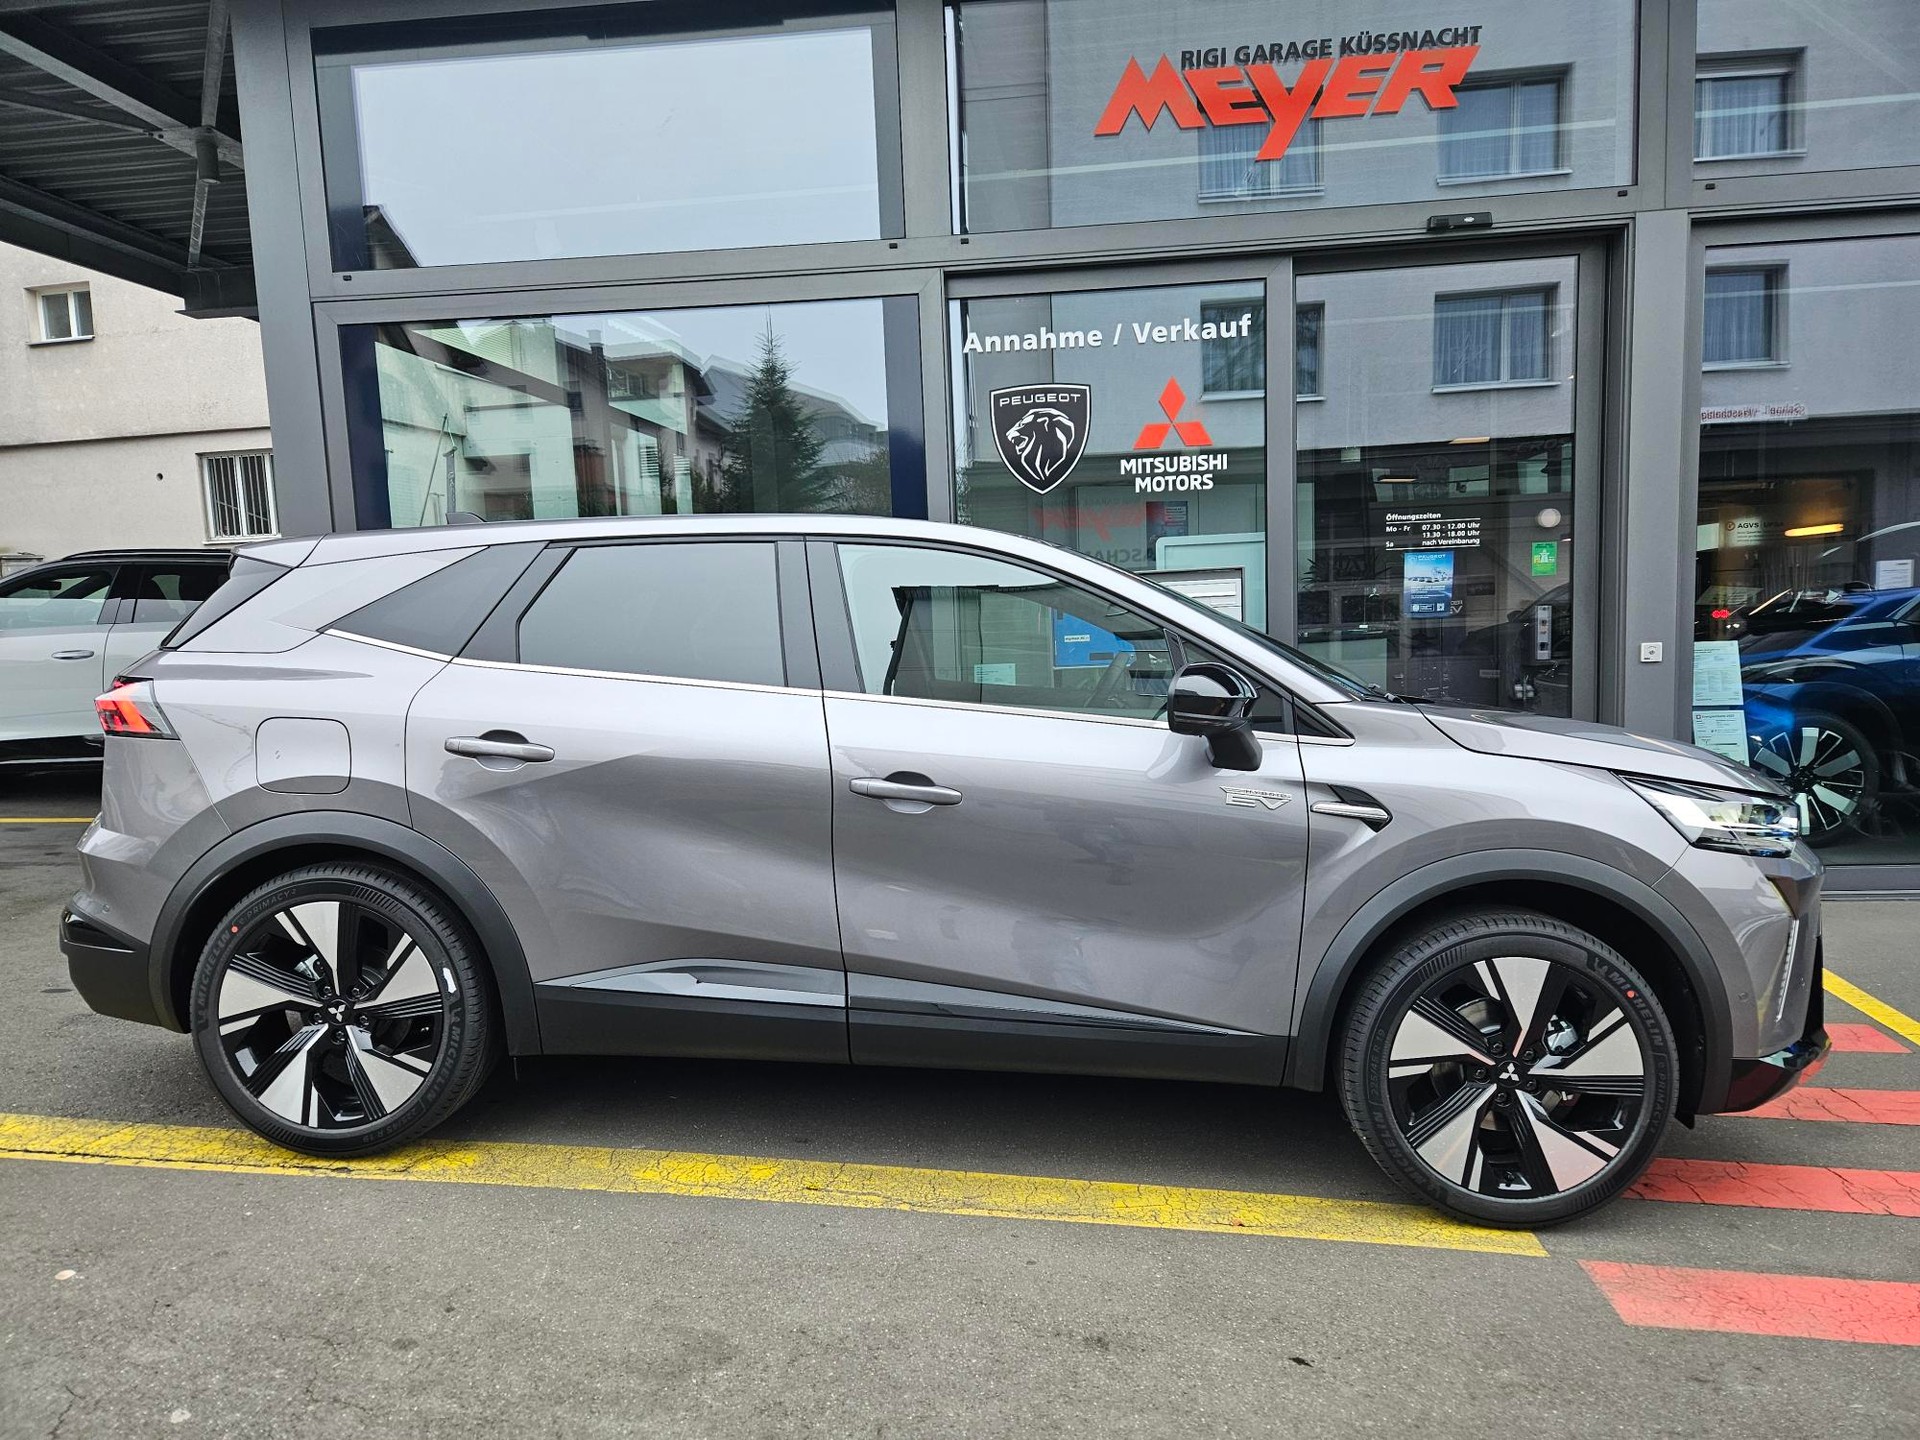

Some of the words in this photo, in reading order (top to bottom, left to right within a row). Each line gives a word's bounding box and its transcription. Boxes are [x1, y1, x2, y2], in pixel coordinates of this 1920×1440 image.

[1180, 46, 1227, 70] RIGI
[1234, 37, 1332, 67] GARAGE
[1340, 25, 1483, 56] KÜSSNACHT
[1093, 43, 1482, 162] MEYER
[963, 327, 1103, 353] Annahme
[1113, 323, 1122, 346] /
[1132, 313, 1252, 344] Verkauf
[999, 393, 1081, 407] PEUGEOT
[1120, 454, 1228, 475] MITSUBISHI
[1135, 474, 1214, 493] MOTORS
[1386, 512, 1441, 521] Öffnungszeiten
[1437, 537, 1480, 546] Vereinbarung
[1607, 970, 1664, 1046] MIHELIN
